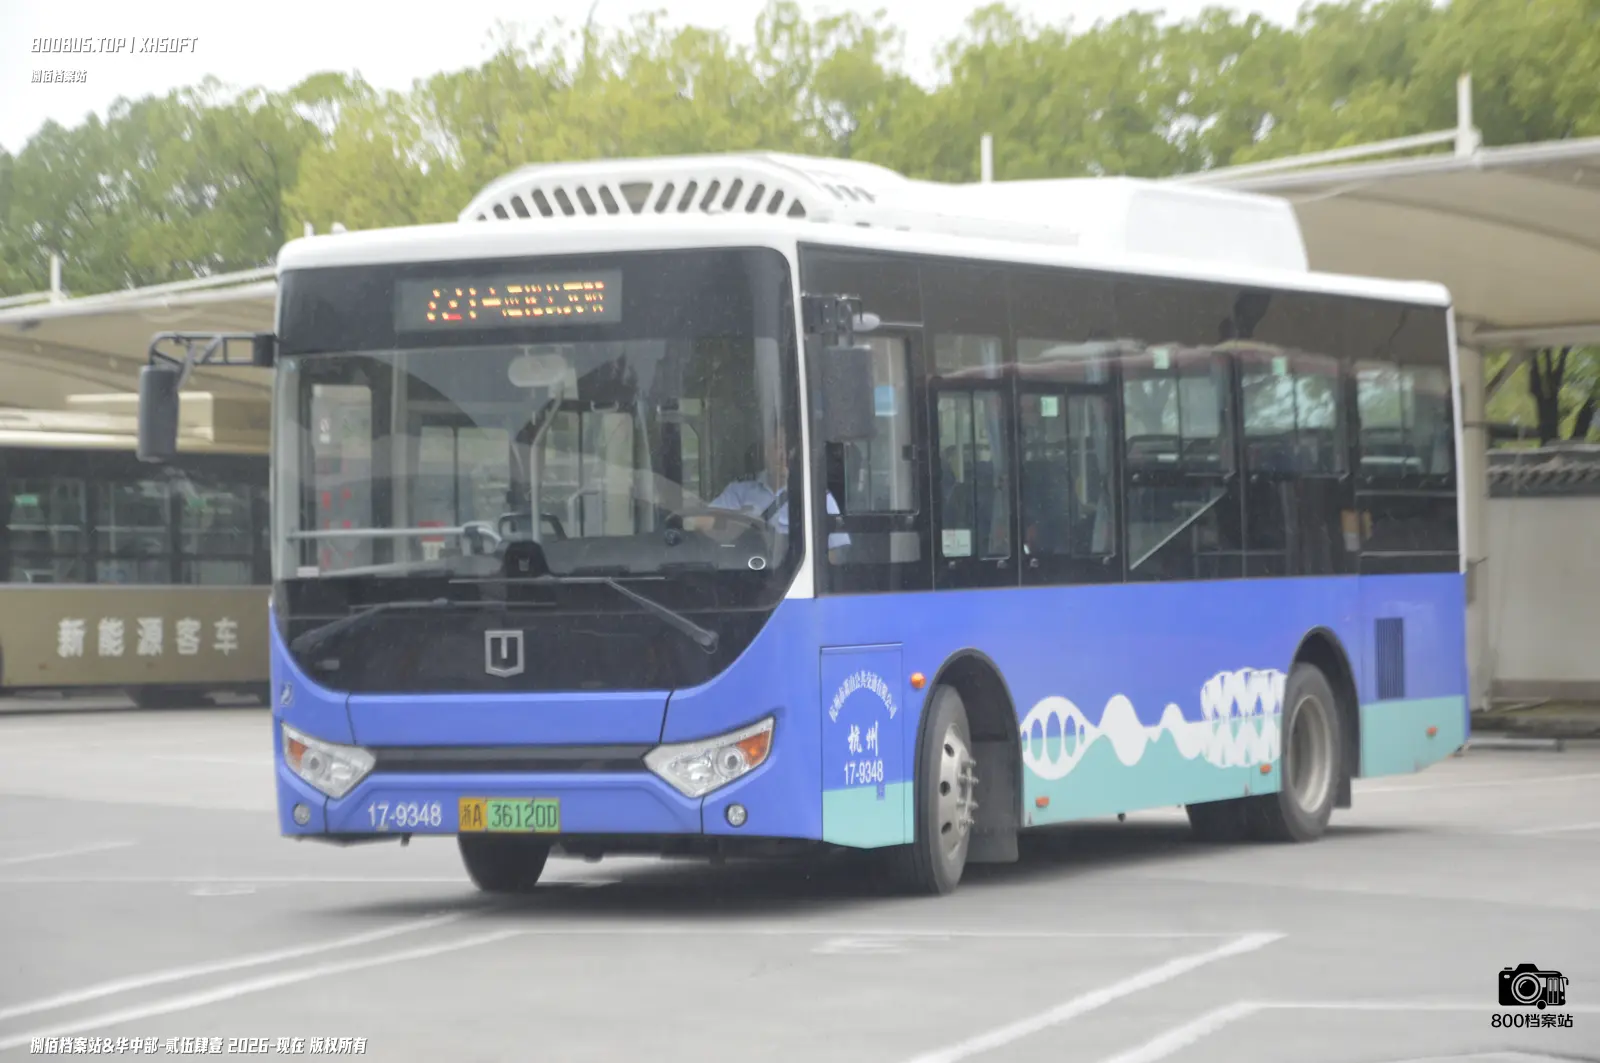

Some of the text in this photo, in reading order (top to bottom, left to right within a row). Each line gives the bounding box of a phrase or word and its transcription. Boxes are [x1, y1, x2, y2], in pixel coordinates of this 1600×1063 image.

[57, 616, 239, 658] 新能源客车
[847, 720, 879, 757] 杭州
[843, 760, 884, 785] 17-9348
[367, 801, 442, 829] 17-9348
